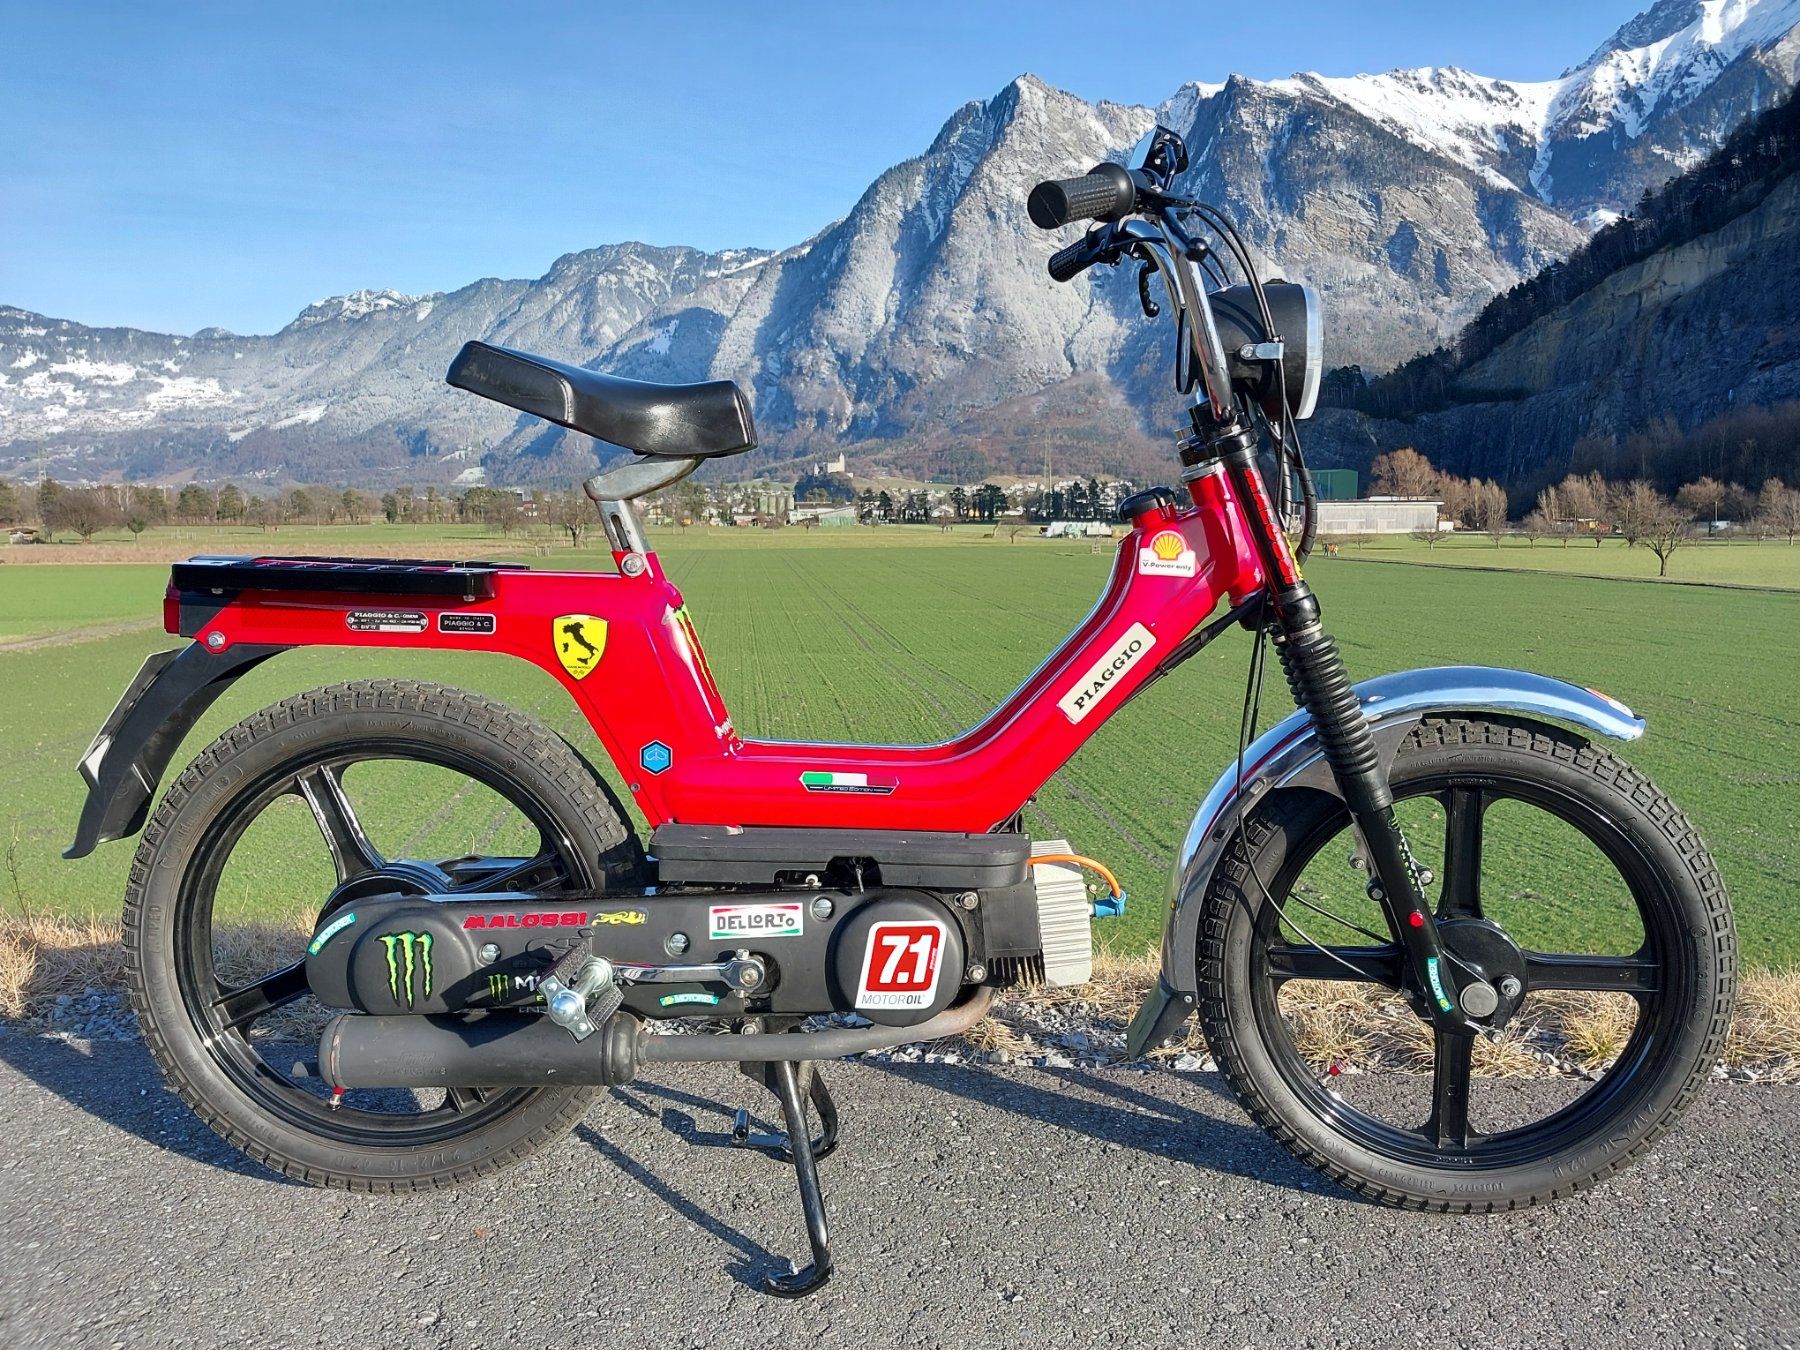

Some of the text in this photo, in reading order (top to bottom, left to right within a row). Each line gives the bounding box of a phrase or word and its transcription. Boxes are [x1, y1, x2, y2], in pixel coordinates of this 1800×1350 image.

[1073, 639, 1142, 710] PIAGGIO
[463, 912, 588, 930] MALOSSI
[879, 934, 932, 984] 7.1
[1428, 961, 1444, 1000] MOTOREX
[674, 993, 715, 1004] MOTOREX
[861, 993, 923, 1005] MOTOROIL
